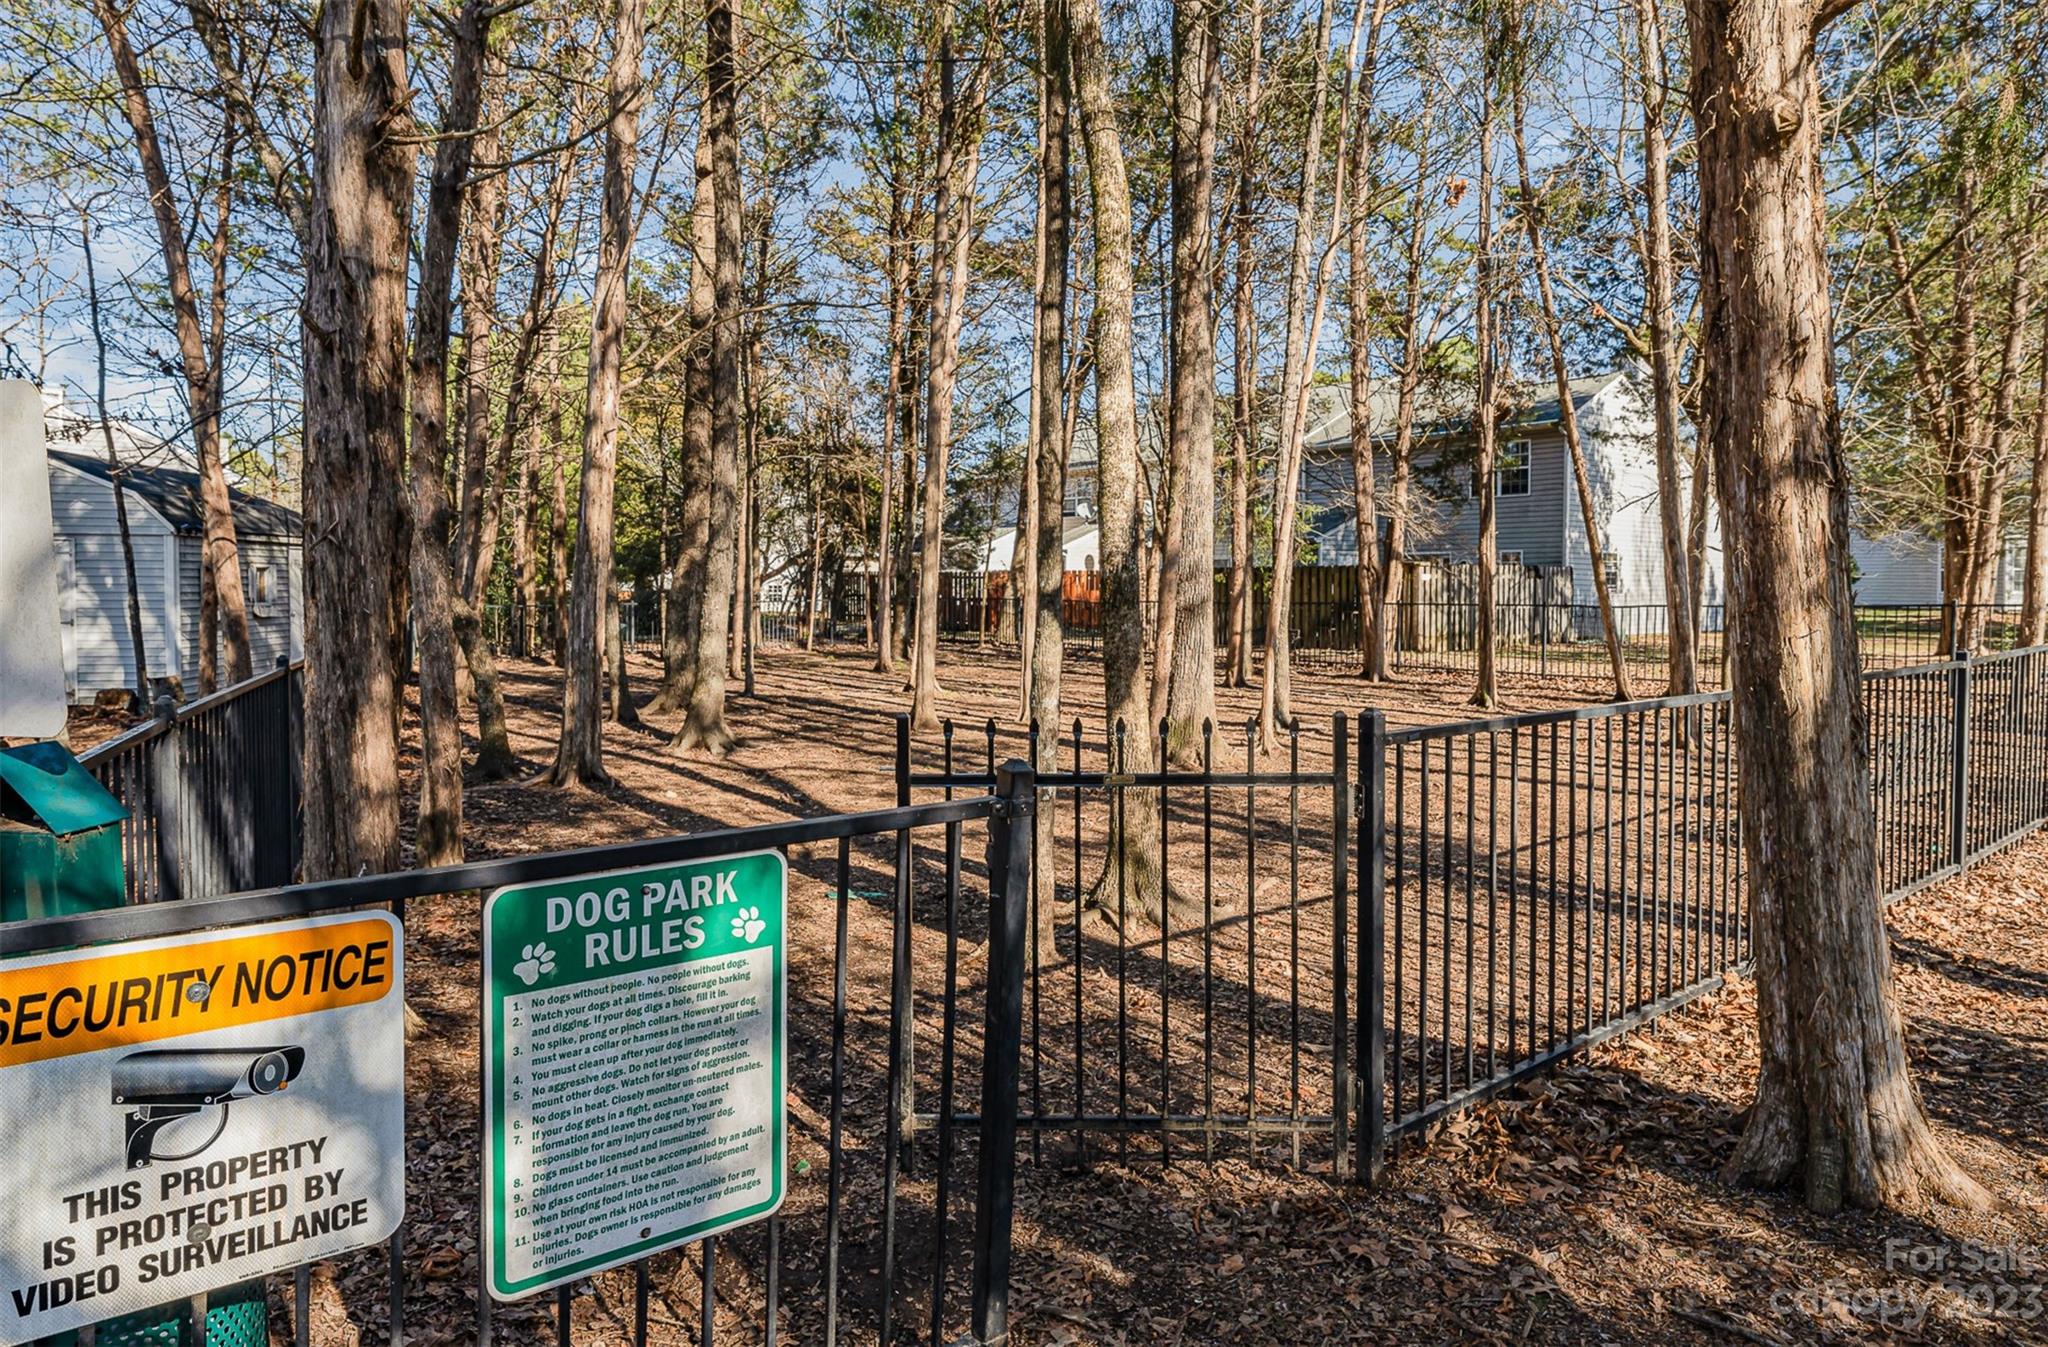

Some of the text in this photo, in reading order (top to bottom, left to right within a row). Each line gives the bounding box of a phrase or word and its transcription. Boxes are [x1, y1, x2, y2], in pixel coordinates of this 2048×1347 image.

[546, 870, 739, 933] DOG PARK
[585, 915, 705, 969] RULES
[232, 940, 389, 1008] NOTICE
[531, 958, 749, 1008] No dogs without people. No people without dogs.
[531, 971, 750, 1022] Watch your dogs all times. Discourage barking
[531, 992, 707, 1036] and digging. your dog digs hole, fill
[531, 996, 756, 1052] No spike, prong pinch collars. However your dog
[531, 1008, 761, 1065] must wear collar harness the run times.
[531, 1027, 738, 1080] You must clean up after your dog immediately.
[531, 1040, 738, 1096] No aggressive dogs. Do not let your dog poster
[531, 1051, 749, 1110] mount other dogs. Watch for signs aggression.
[531, 1061, 763, 1125] No dogs heat. Closely monitor un-neutered males.
[541, 1082, 728, 1140] your dog gets fight, exchange contact
[532, 1097, 723, 1153] information and leave the dog run. You are
[532, 1106, 735, 1167] responsible for any injury caused your dog.
[532, 1126, 708, 1182] Dogs must be licensed and immunized.
[62, 1136, 328, 1224] THIS PROPERTY
[514, 1142, 748, 1218] 10. No glass containers. Use caution and judgement
[532, 1124, 765, 1197] Children under 14 must be accompanied adult.
[43, 1168, 344, 1271] IS PROTECTED BY
[514, 1167, 756, 1247] 11. Use your own risk HOA not responsible for any
[532, 1177, 679, 1226] when bringing food into the run.
[532, 1178, 760, 1255] injuries. Dogs owner responsible for any damages
[11, 1264, 120, 1318] VIDEO
[138, 1198, 368, 1283] SURVEILLANCE
[544, 1247, 584, 1264] injuries.
